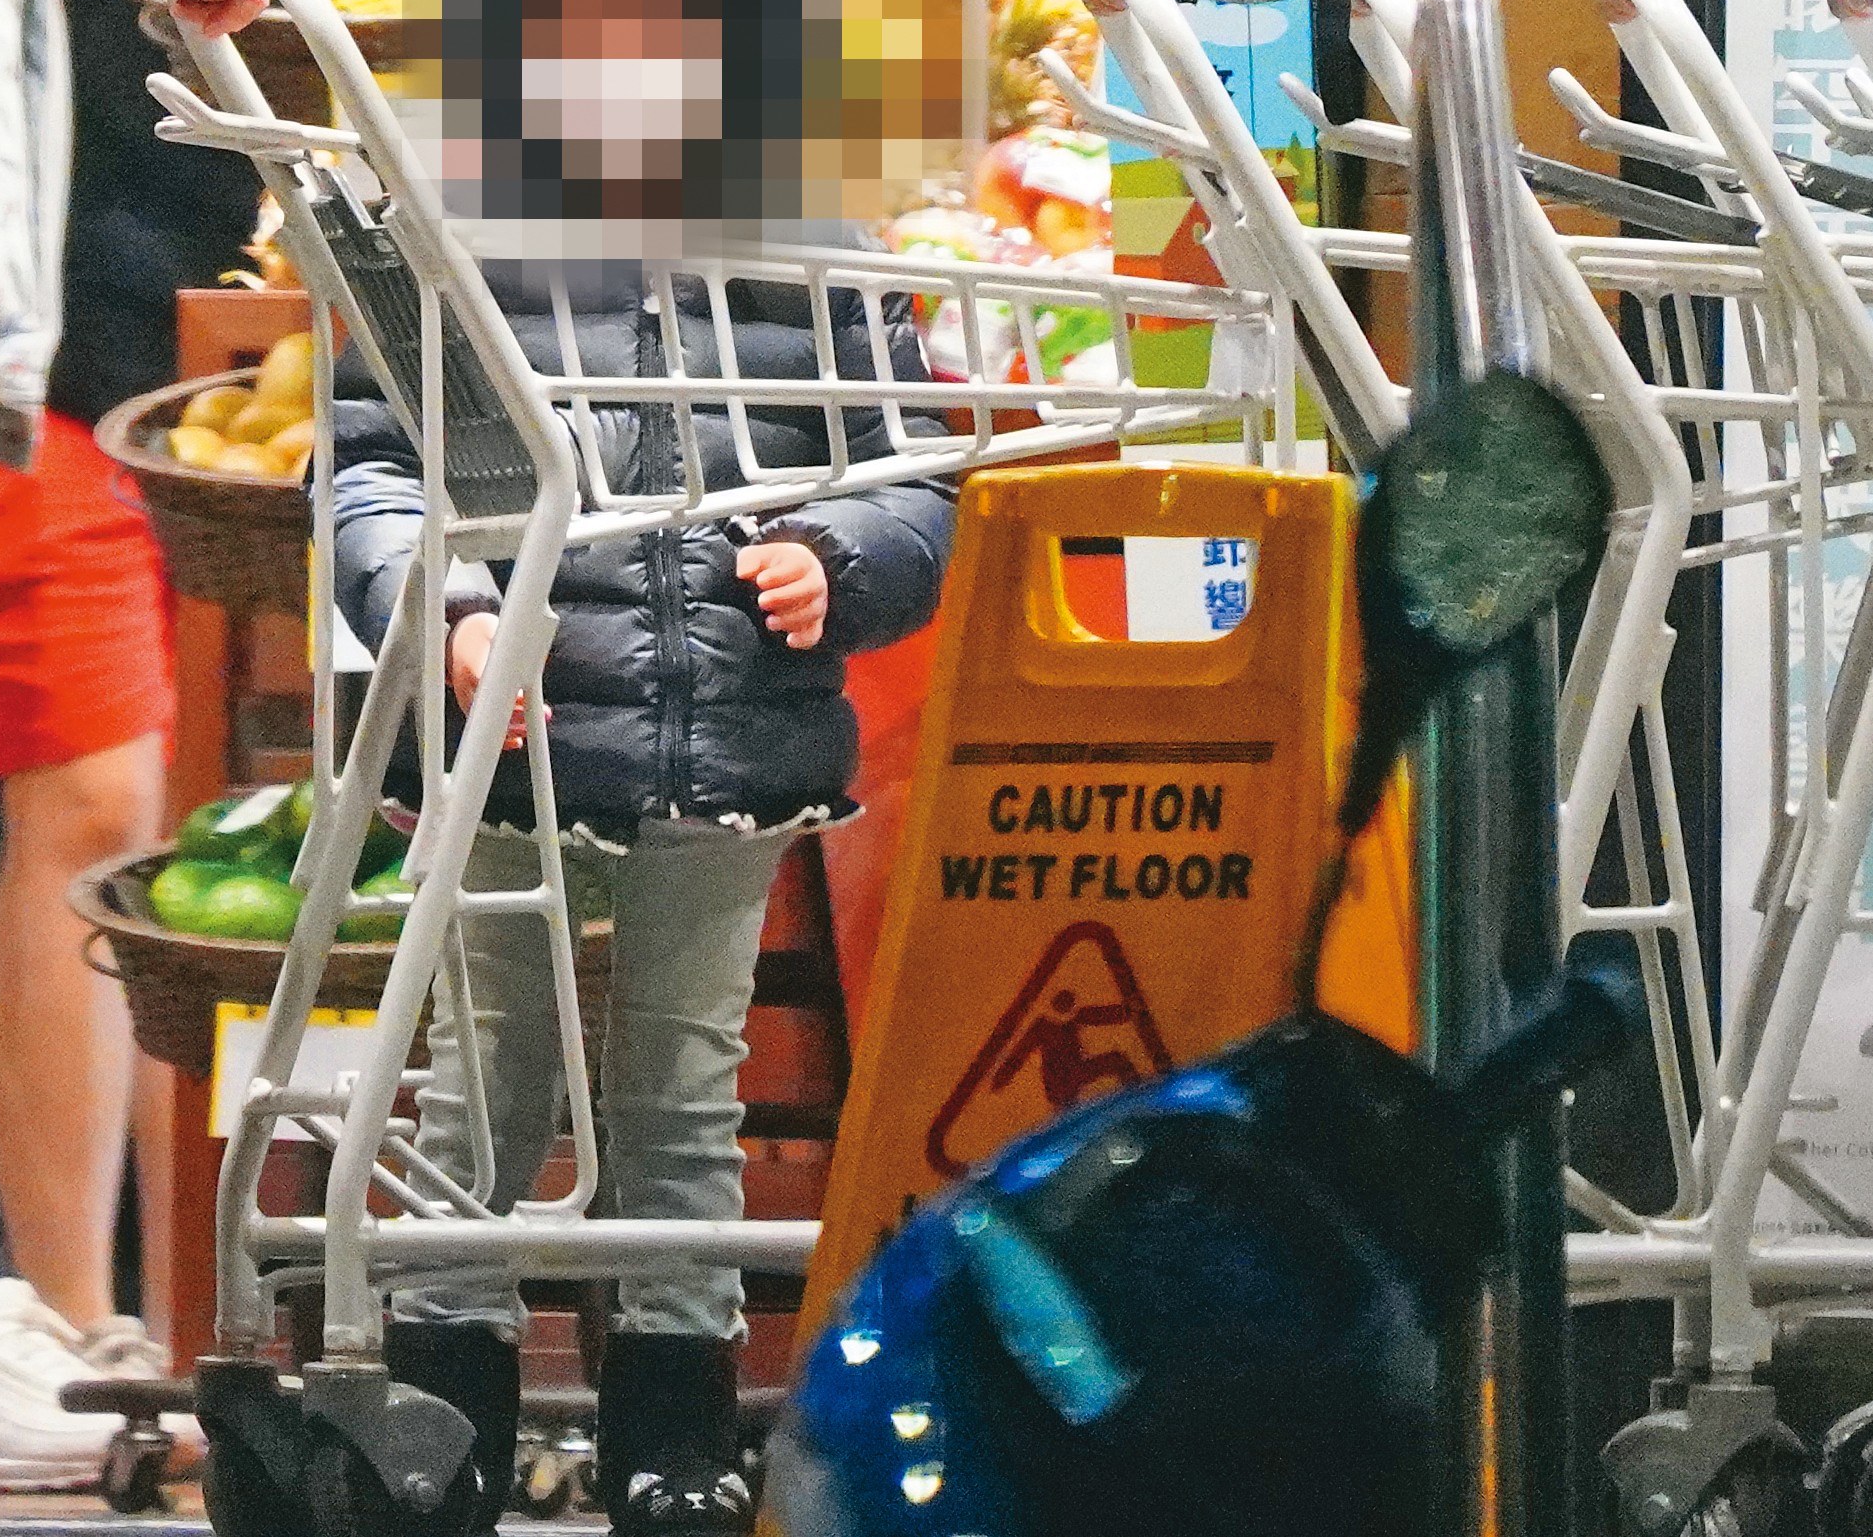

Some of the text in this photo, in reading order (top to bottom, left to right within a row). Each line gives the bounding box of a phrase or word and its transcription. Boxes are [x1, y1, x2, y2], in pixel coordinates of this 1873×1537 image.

[988, 784, 1223, 833] CAUTION
[940, 854, 1253, 901] WET FLOOR
